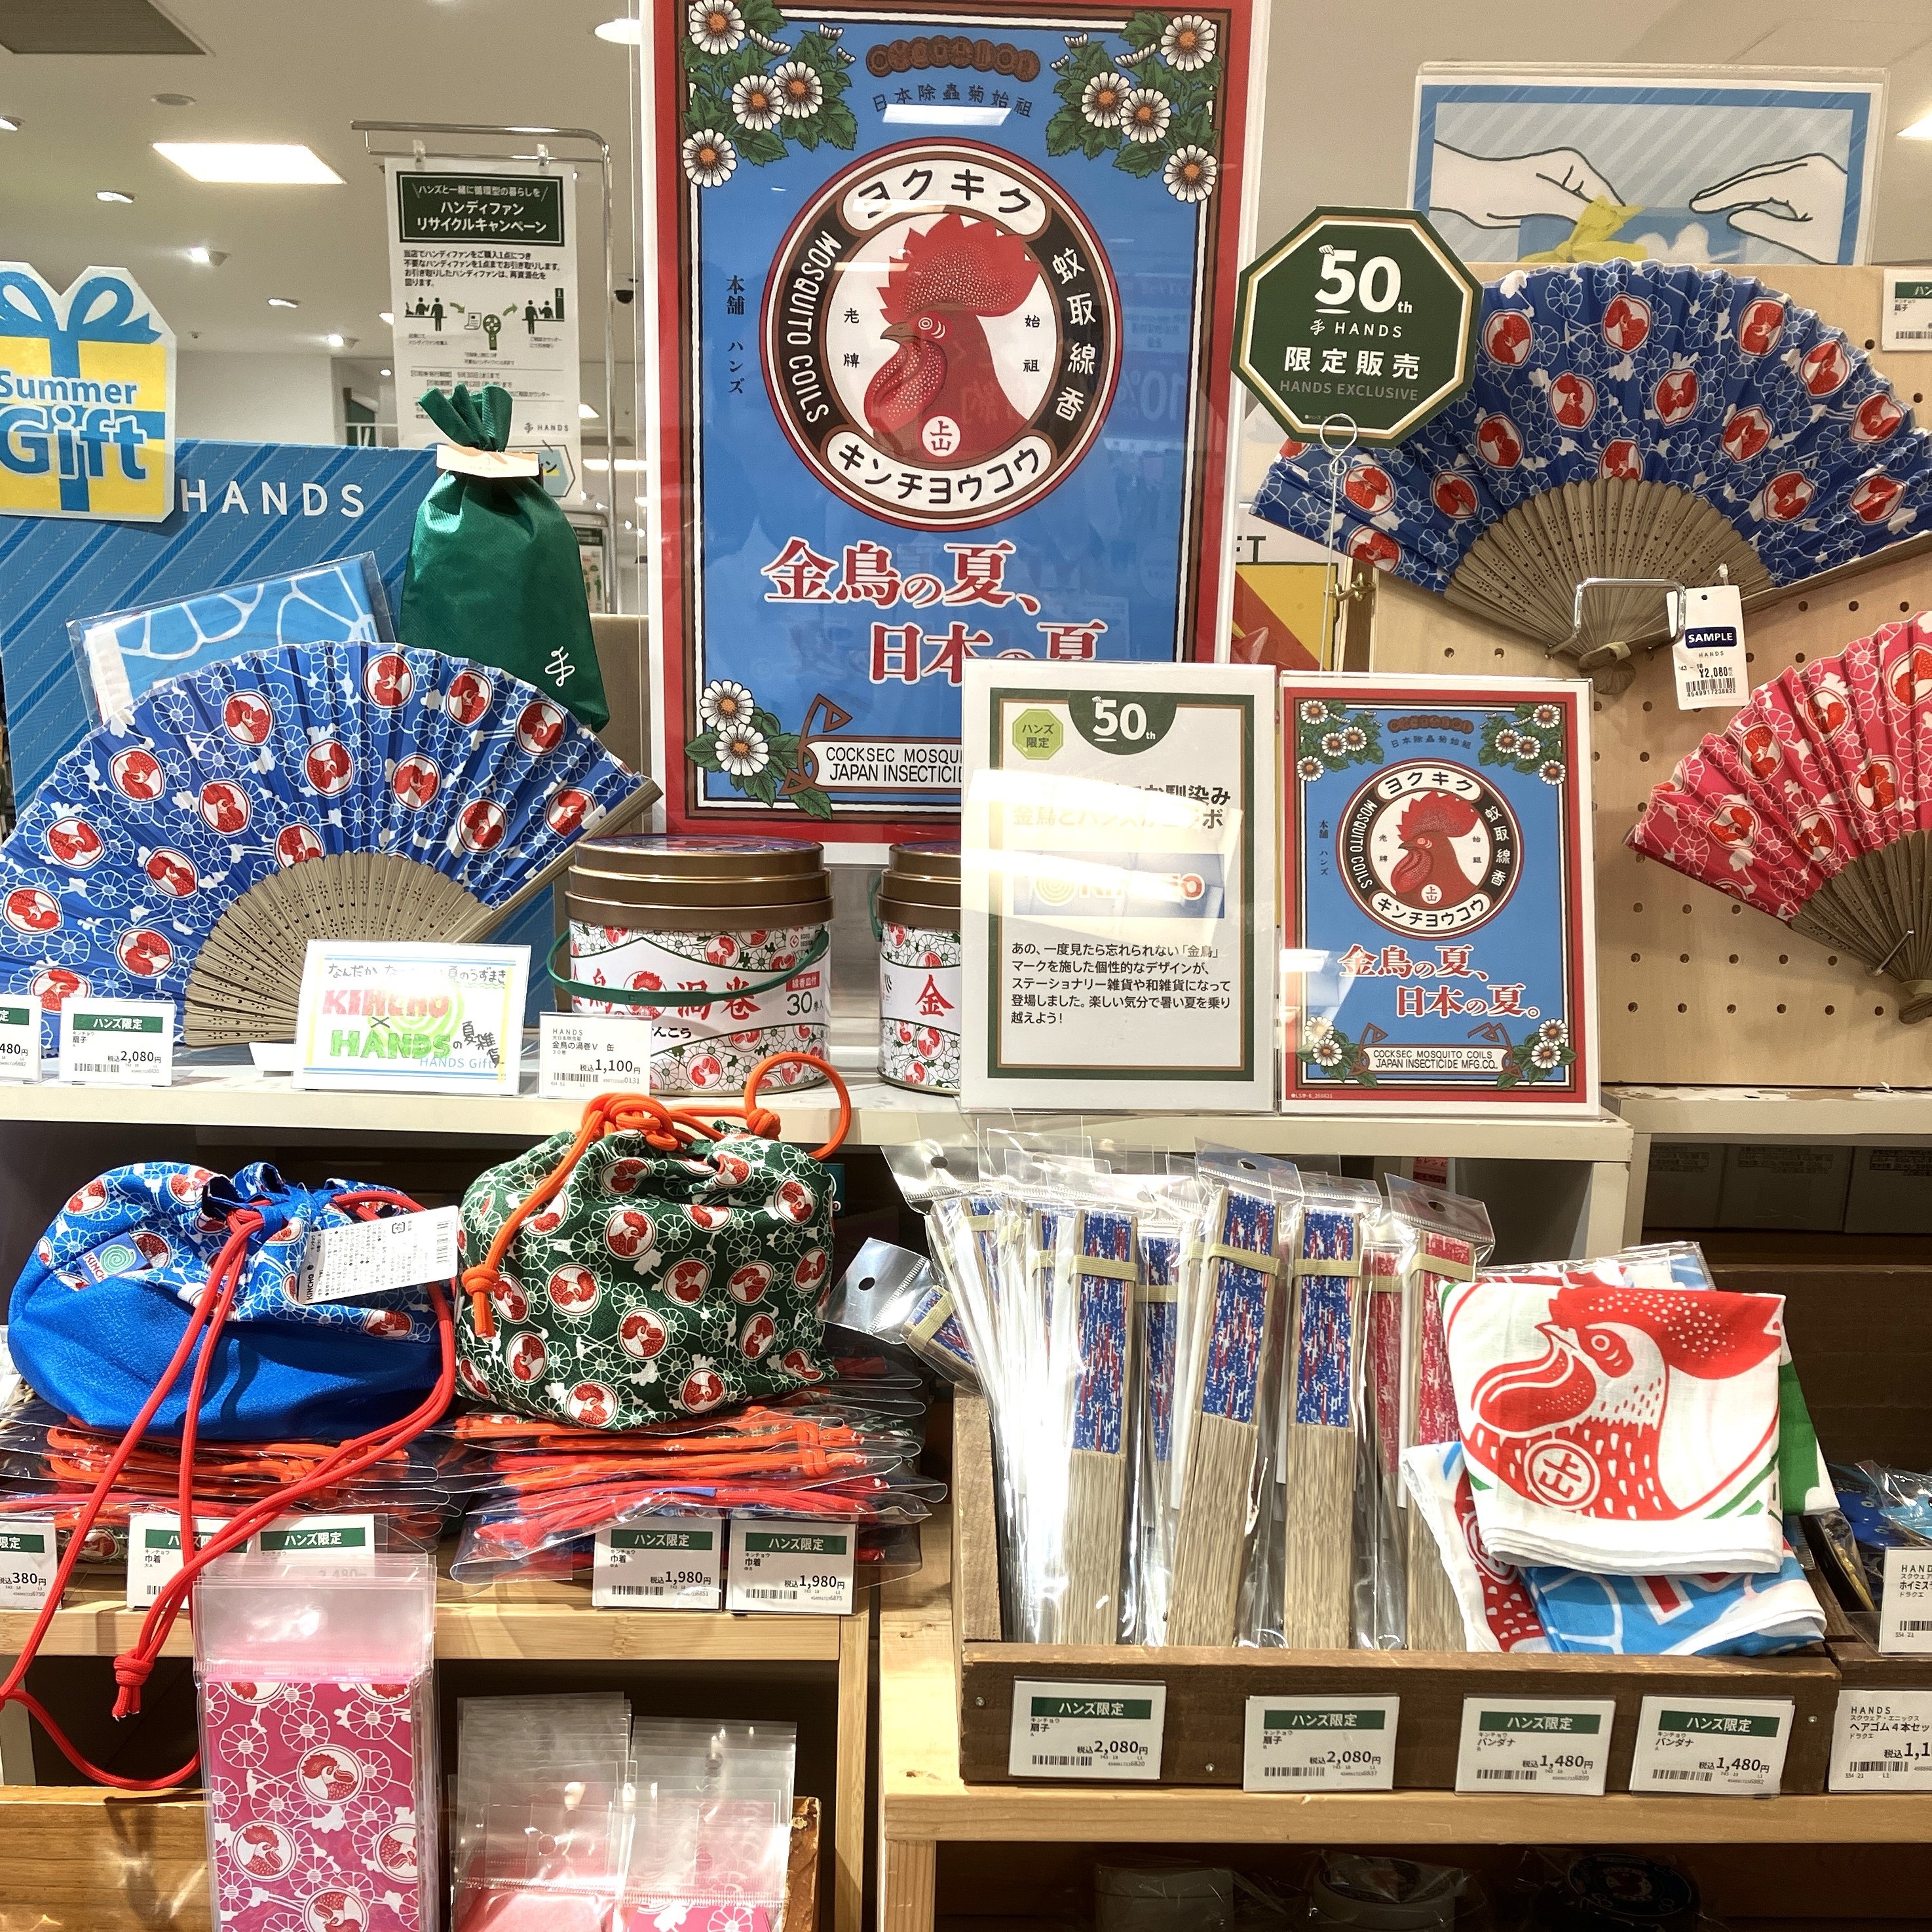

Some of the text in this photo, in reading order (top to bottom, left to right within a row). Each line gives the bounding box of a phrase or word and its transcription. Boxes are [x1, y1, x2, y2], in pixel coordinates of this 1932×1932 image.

[872, 83, 1033, 118] 日本除蟲菊始祖
[858, 168, 1032, 219] ヨクキク
[440, 200, 525, 216] ハンディファン
[417, 217, 547, 233] リサイクルキャンペーン
[725, 275, 746, 395] 本舗 ハンズ
[786, 231, 843, 424] MOSQUITO COILS
[1051, 247, 1097, 422] 蚊取線香
[1335, 322, 1403, 339] HANDS
[1283, 346, 1421, 380] 限定販売
[0, 370, 137, 404] Summer
[1279, 379, 1420, 402] HANDS EXCLUSIVE
[537, 424, 569, 432] HANDS
[0, 404, 147, 480] Gift
[181, 478, 366, 518] HANDS
[761, 537, 1041, 615] 金鳥の夏、
[1688, 632, 1733, 643] SAMPLE
[1021, 723, 1055, 735] ハンズ
[1026, 736, 1050, 750] 限定
[826, 747, 962, 765] COCKSEC MOSQUI
[829, 763, 962, 783] JAPAN INSECTICI
[1384, 771, 1474, 795] ヨクキク
[1350, 799, 1378, 890] MOSQUITO COILS
[1484, 805, 1511, 887] 蚊取線香
[1011, 942, 1221, 958] あの、一度見たら忘れられない「金鳥」
[1011, 960, 1210, 975] マークを施した個性的なデザインが、
[1338, 944, 1489, 981] 金鳥の夏、
[328, 964, 378, 979] なんだか
[1011, 977, 1232, 993] ステーショナリー雑貨や和雑貨になって
[915, 974, 955, 1017] 金
[1010, 994, 1232, 1010] 登場しました。楽しい気分で暑い夏を乗り
[1395, 983, 1540, 1019] 日本の夏。
[93, 1017, 143, 1031] ハンズ限定
[652, 1026, 692, 1040] んこう
[330, 1029, 452, 1059] HANDS
[1373, 1050, 1412, 1058] COCKSEC
[1416, 1050, 1463, 1059] MOSQUITO
[420, 1057, 493, 1070] HANDS Gift
[1375, 1058, 1403, 1069] JAPAN
[1405, 1059, 1458, 1069] INSECTICIDE
[306, 1273, 314, 1301] KINCHO
[284, 1532, 343, 1547] ハンズ限定
[634, 1533, 690, 1547] ハンズ限定
[768, 1537, 824, 1551] ハンズ限定
[144, 1555, 161, 1564] 巾着
[610, 1555, 626, 1564] 巾着
[745, 1557, 761, 1567] 巾着
[1900, 1580, 1932, 1591] ホイミス
[1058, 1701, 1124, 1716] ハンズ限定
[1851, 1706, 1891, 1714] HANDS
[1291, 1713, 1358, 1728] ハンズ限定
[1507, 1716, 1574, 1731] ハンズ限定
[1686, 1716, 1752, 1733] ハンズ限定
[1477, 1737, 1516, 1747] バンダナ
[1655, 1737, 1694, 1747] バンダナ
